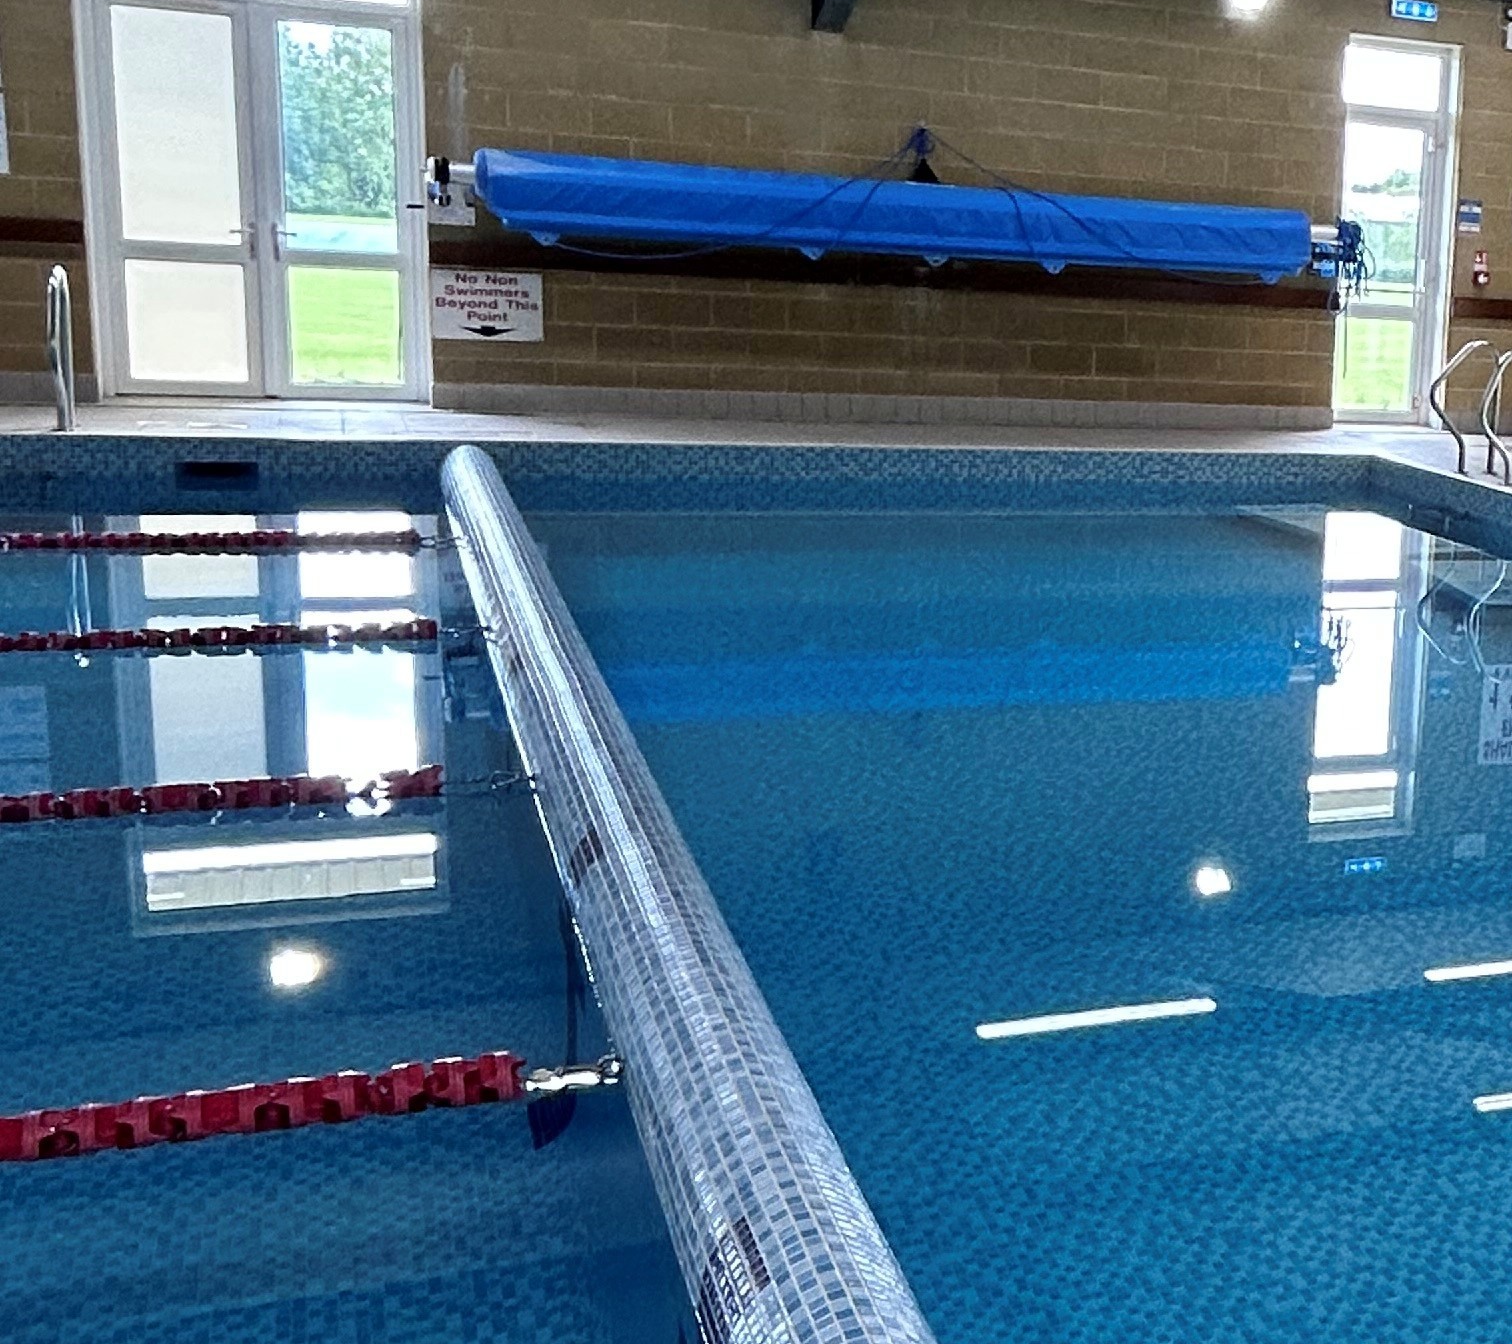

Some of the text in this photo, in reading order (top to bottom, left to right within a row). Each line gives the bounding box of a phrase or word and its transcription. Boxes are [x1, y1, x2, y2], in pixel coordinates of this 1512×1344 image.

[455, 273, 518, 285] No Non
[444, 284, 530, 298] Swimmers
[435, 296, 539, 311] Beyond This
[466, 310, 508, 322] Point
